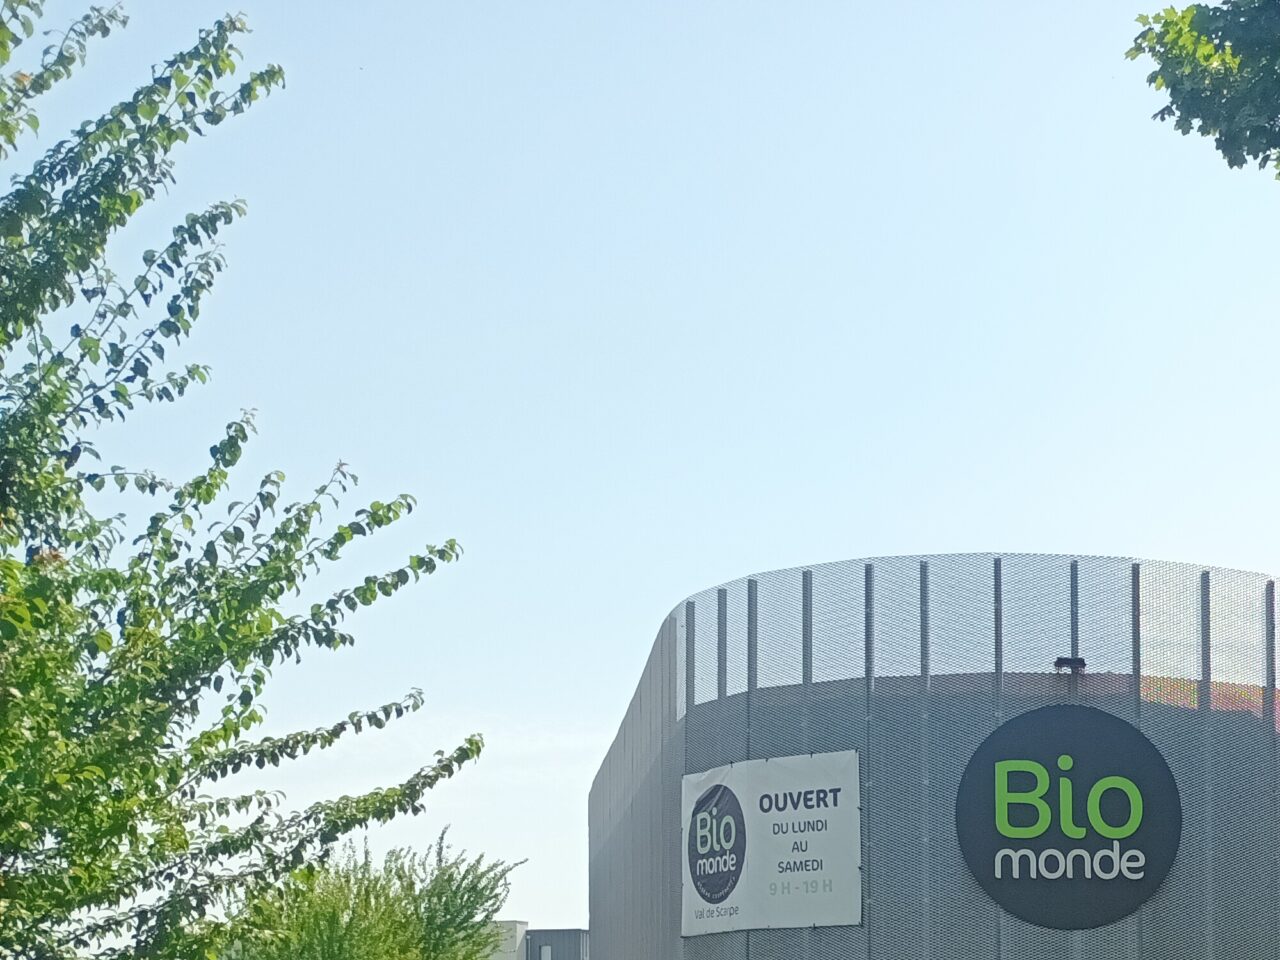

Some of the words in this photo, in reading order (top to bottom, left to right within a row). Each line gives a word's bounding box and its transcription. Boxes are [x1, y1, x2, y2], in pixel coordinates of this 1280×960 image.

[759, 787, 842, 813] OUVERT
[994, 754, 1144, 839] Bio
[696, 806, 736, 855] Bio
[772, 822, 790, 836] DU
[792, 819, 828, 834] LUNDI
[791, 840, 808, 853] AU
[994, 839, 1146, 880] monde
[696, 850, 737, 876] monde
[777, 859, 823, 874] SAMEDI
[769, 882, 777, 896] 9
[781, 881, 791, 895] H
[803, 880, 819, 894] 19
[822, 879, 833, 893] H
